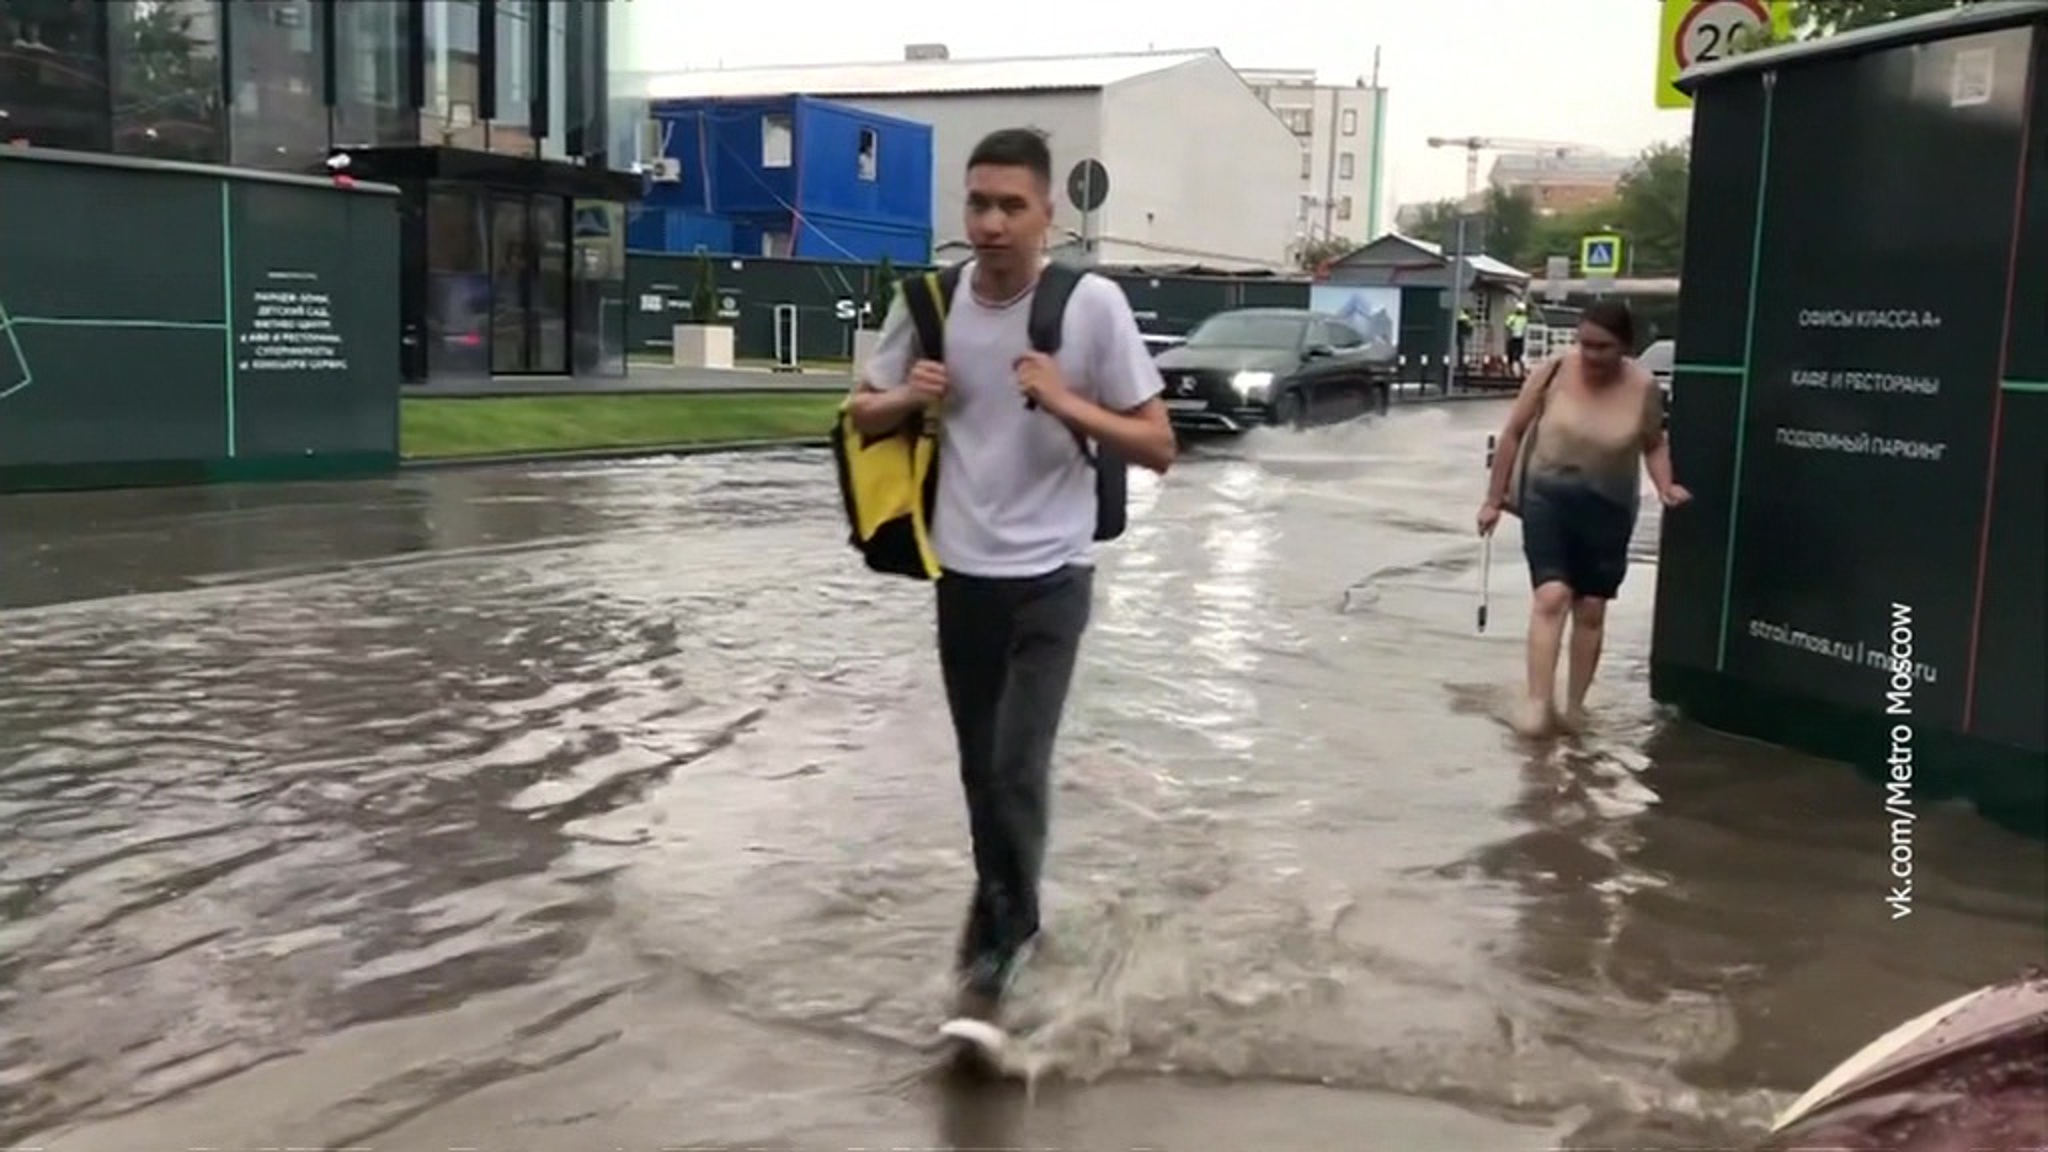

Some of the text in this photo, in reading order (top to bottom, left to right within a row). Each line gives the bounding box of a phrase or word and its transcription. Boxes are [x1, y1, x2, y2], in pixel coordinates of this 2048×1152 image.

[1799, 309, 1853, 327] ОФИСЫ
[1856, 310, 1919, 329] КЛАССА
[1791, 370, 1940, 395] КАФЕ И РЕСТОРАНЫ
[1775, 427, 1946, 461] ПОДЗЕМНЫЙ ПАРКИНГ
[1866, 649, 1937, 683] m.ru
